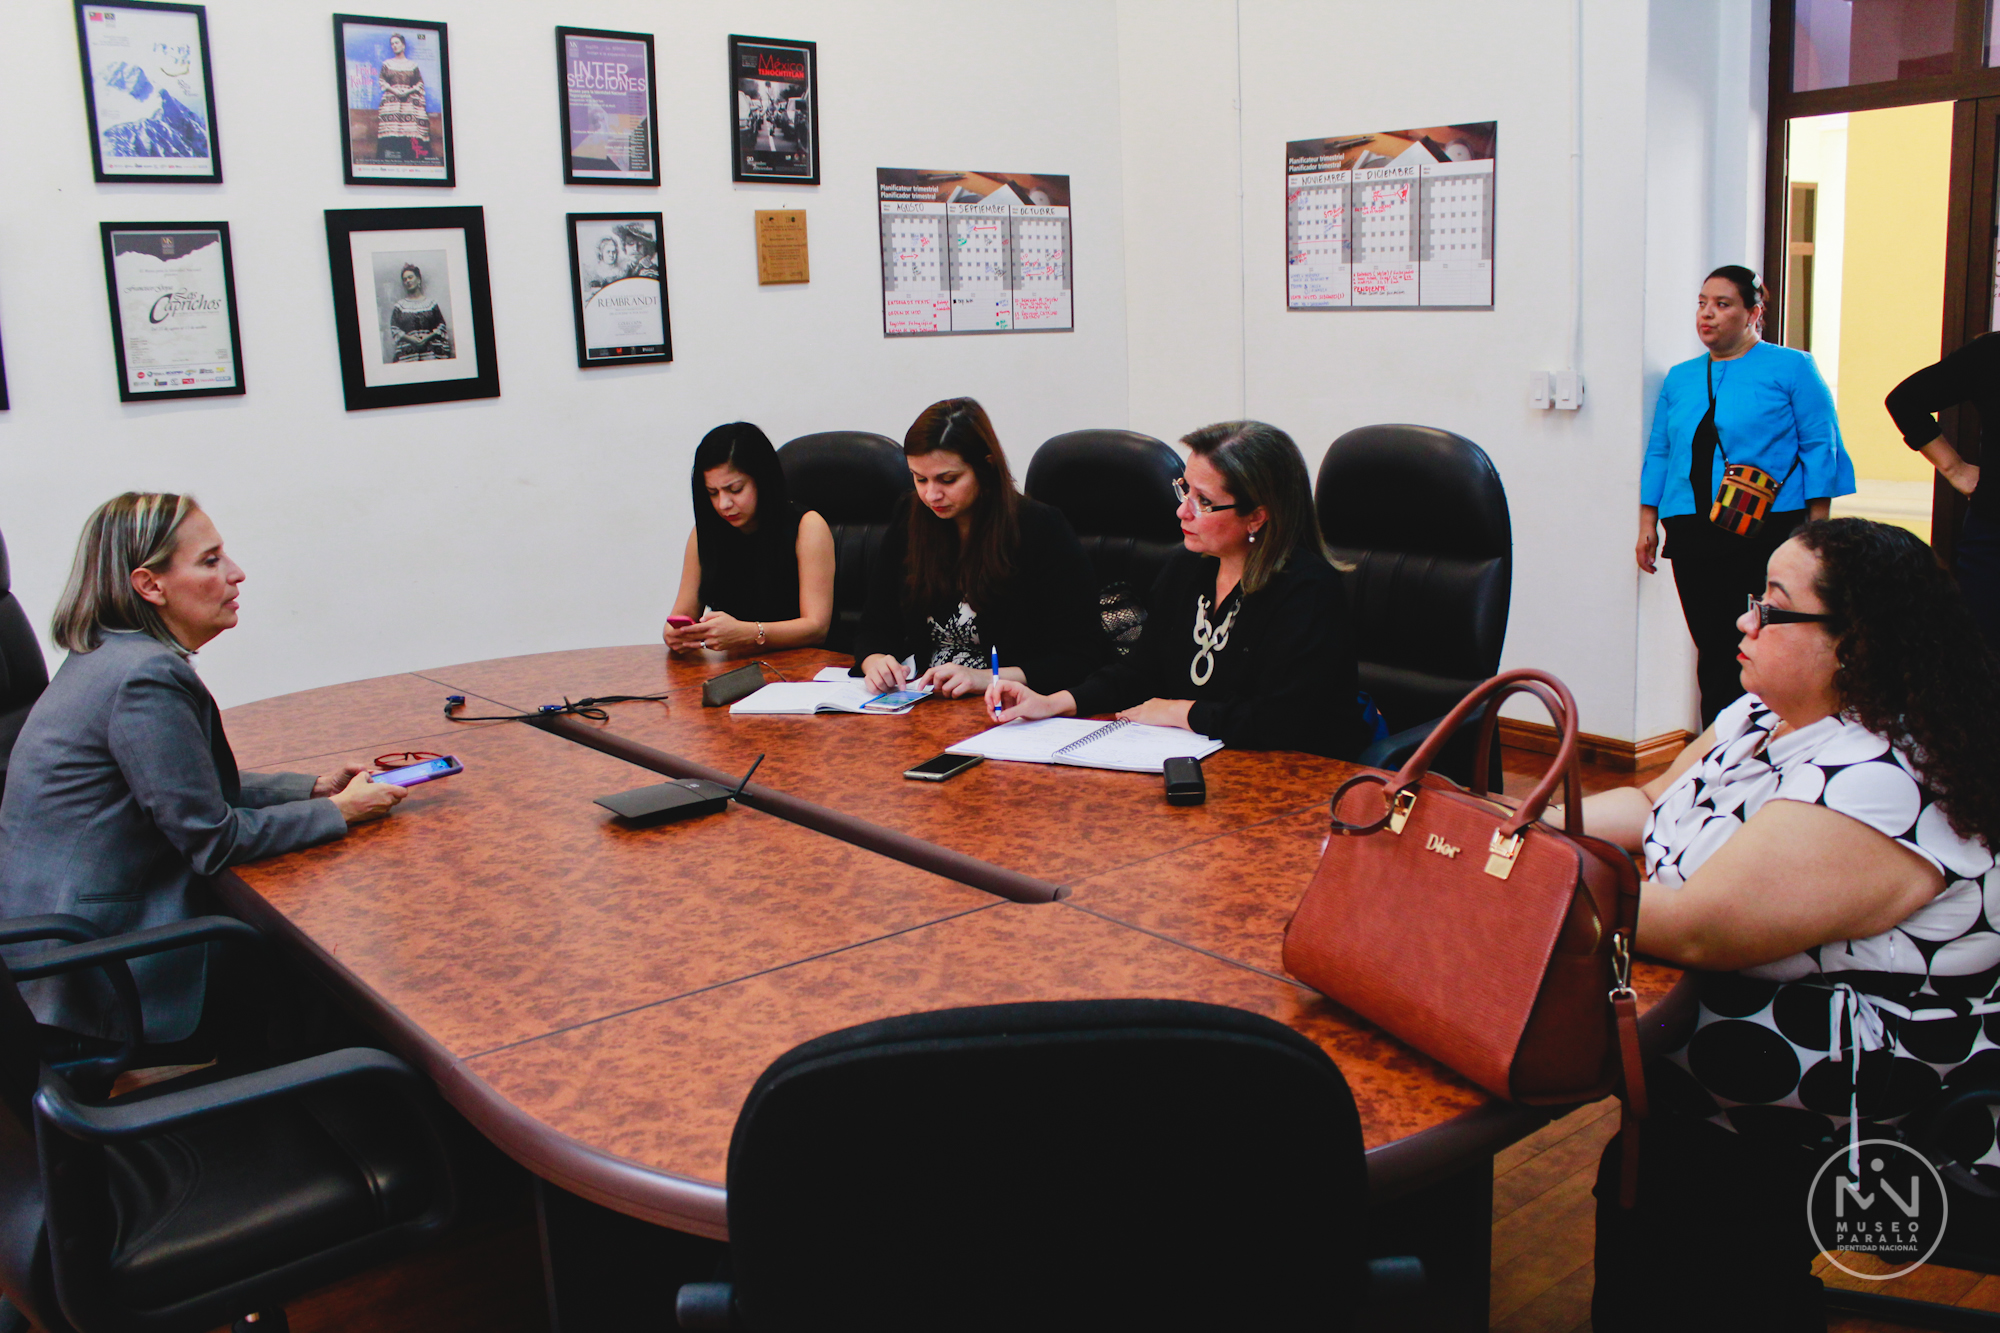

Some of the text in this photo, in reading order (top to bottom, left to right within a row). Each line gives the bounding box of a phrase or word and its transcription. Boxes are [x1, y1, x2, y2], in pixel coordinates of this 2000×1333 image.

[758, 53, 804, 72] México
[573, 60, 629, 82] INTER
[567, 73, 647, 92] SECCIONES
[1301, 172, 1346, 186] NOVIEMBRE
[1366, 166, 1415, 180] DICIEMBRE
[896, 202, 925, 213] AGOSTO
[958, 204, 1006, 214] SEPTIEMBRE
[1020, 207, 1056, 216] OCTUBRE
[597, 296, 658, 307] REMBRANDT
[149, 293, 222, 325] Caprichos
[1425, 833, 1462, 858] Dior
